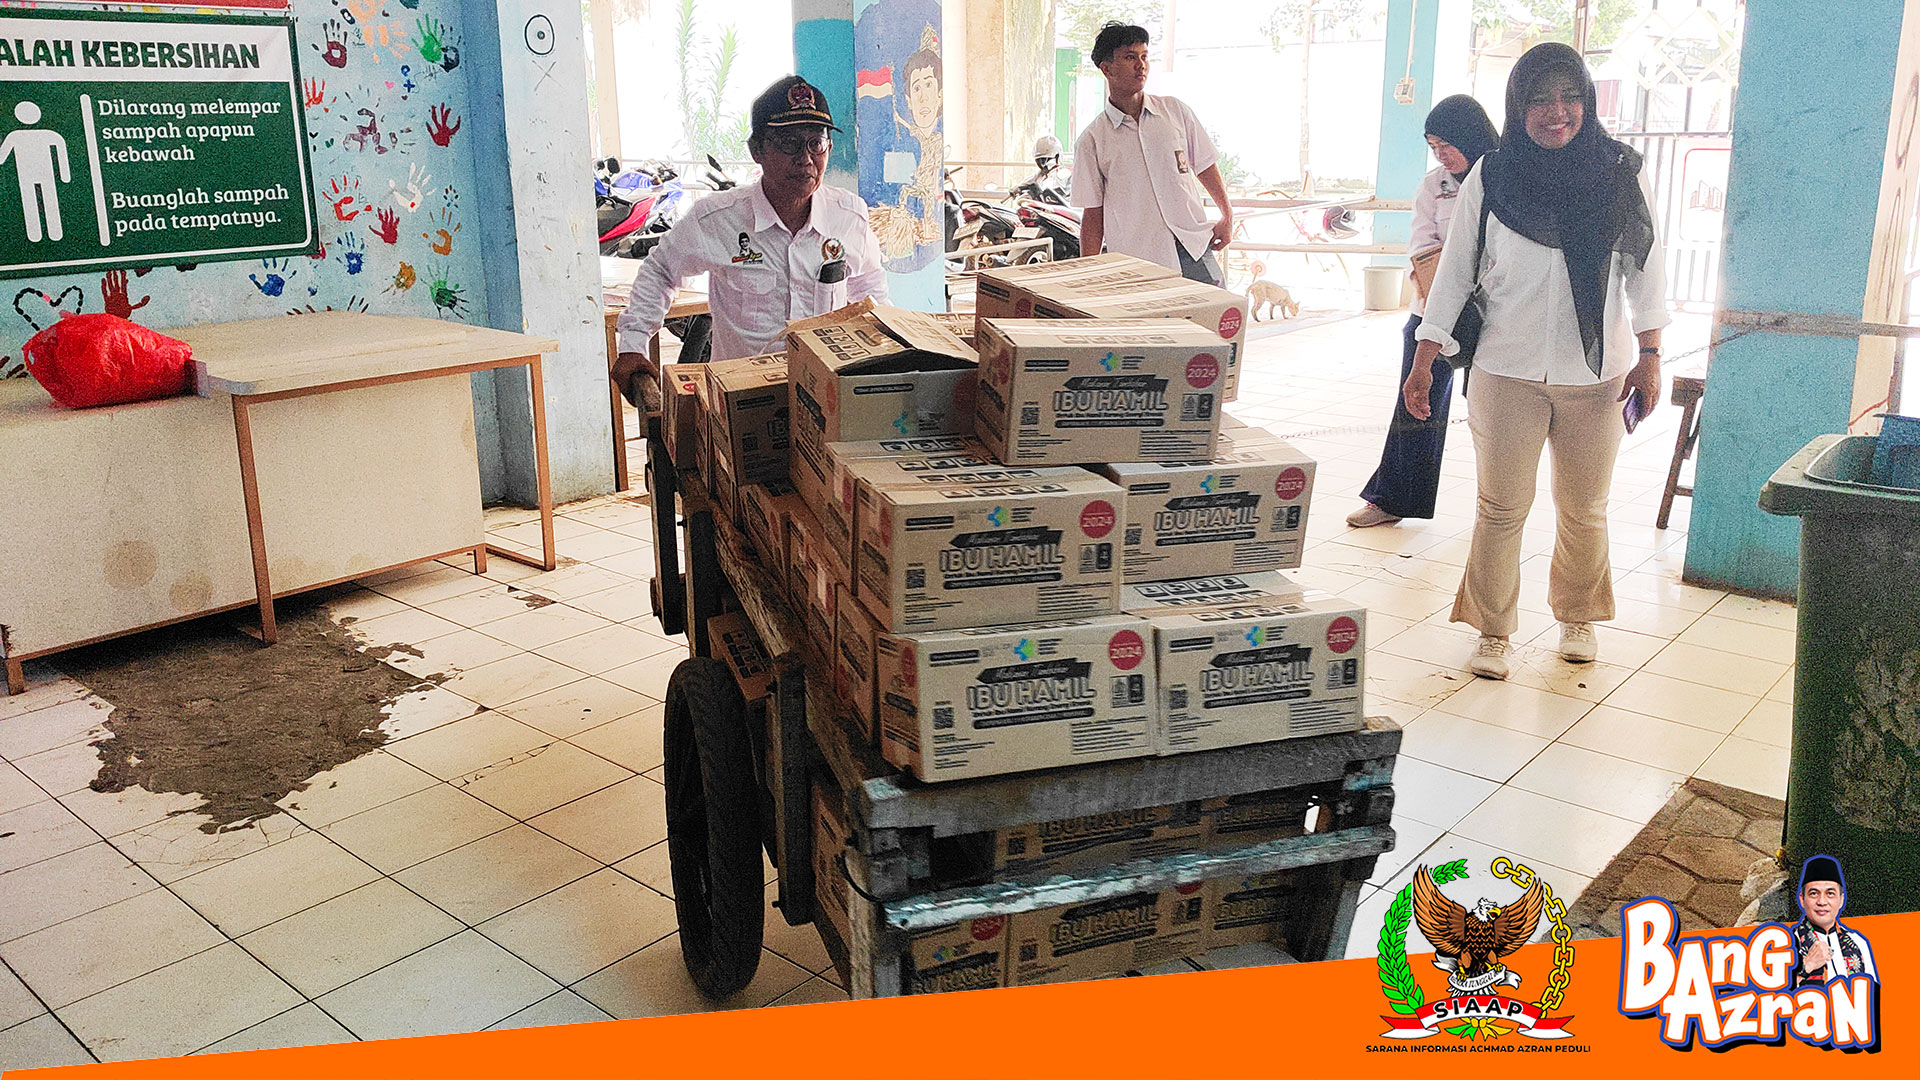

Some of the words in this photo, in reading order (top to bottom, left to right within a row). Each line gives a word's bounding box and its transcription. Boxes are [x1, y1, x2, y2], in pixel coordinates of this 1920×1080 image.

[81, 41, 260, 69] KEBERSIHAN
[98, 99, 187, 119] Dilarang
[190, 98, 281, 118] melempar
[102, 122, 182, 143] sampah
[185, 125, 255, 141] apapun
[105, 145, 195, 163] kebawah
[111, 187, 209, 210] Buanglah
[214, 184, 289, 205] sampah
[115, 214, 167, 237] pada
[170, 210, 282, 230] tempatnya.
[1220, 320, 1240, 331] 2024
[1187, 368, 1218, 378] 2024
[1053, 390, 1093, 413] IBU
[1096, 390, 1169, 411] HAMIL
[1276, 478, 1303, 491] 2024
[1082, 516, 1114, 529] 2024
[1153, 510, 1190, 532] IBU
[1194, 506, 1261, 530] HAMIL
[939, 548, 983, 573] IBU
[986, 543, 1064, 571] HAMIL
[1200, 668, 1241, 692] IBU
[1243, 660, 1316, 686] HAMIL
[967, 684, 1012, 710] IBU
[1014, 676, 1097, 706] HAMIL
